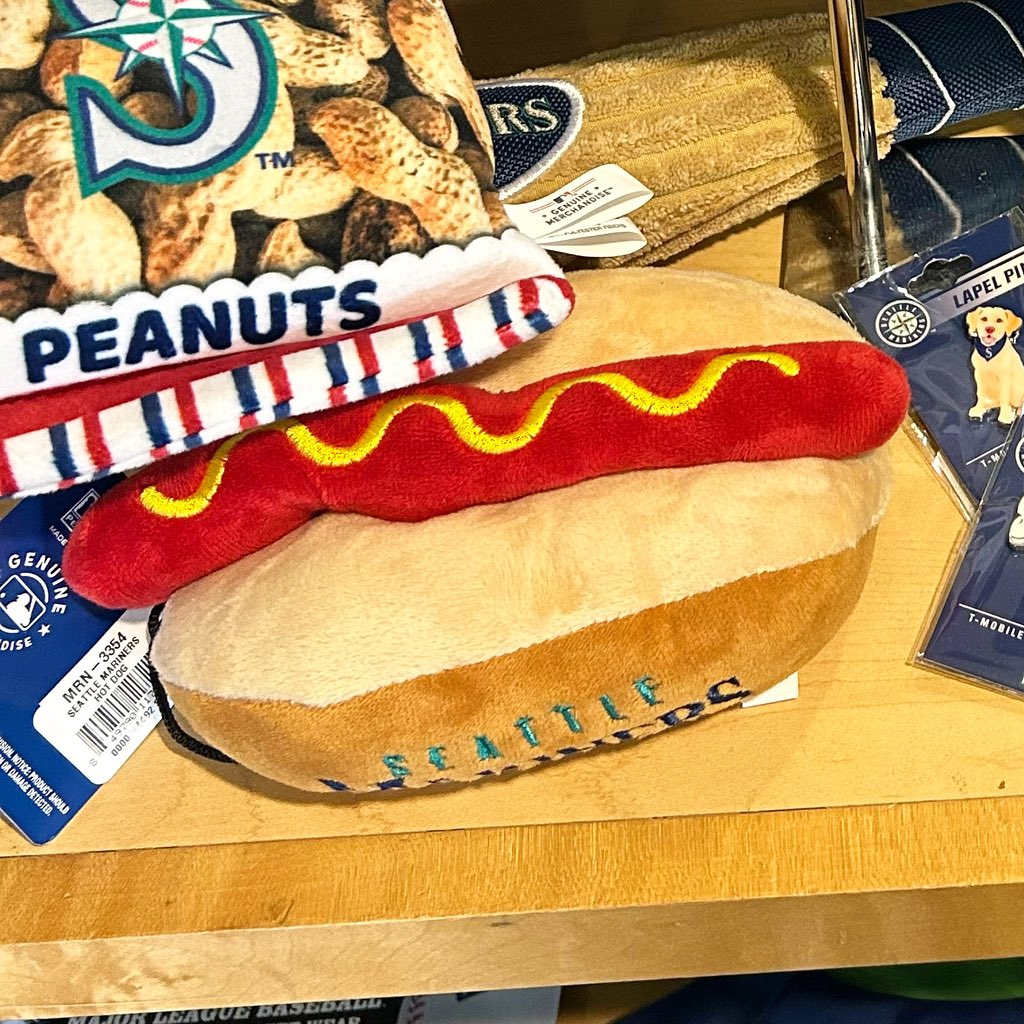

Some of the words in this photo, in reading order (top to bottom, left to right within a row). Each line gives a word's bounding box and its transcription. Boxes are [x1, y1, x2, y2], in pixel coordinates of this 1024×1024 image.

[551, 189, 594, 216] GENUINE
[952, 277, 1003, 309] LAPEL
[21, 278, 383, 384] PEANUTS
[48, 525, 69, 547] MADE
[8, 552, 69, 614] GENUINE
[968, 612, 1024, 640] T-MOBILE
[62, 670, 93, 704] MRN
[98, 631, 128, 663] 3354
[67, 679, 102, 718] SEATTLE
[99, 636, 141, 681] MARINERS
[94, 684, 111, 703] HOT
[110, 663, 129, 684] DOG
[7, 768, 32, 793] DAMAGE
[28, 771, 54, 797] PRODUCT
[48, 791, 71, 815] SHOULD
